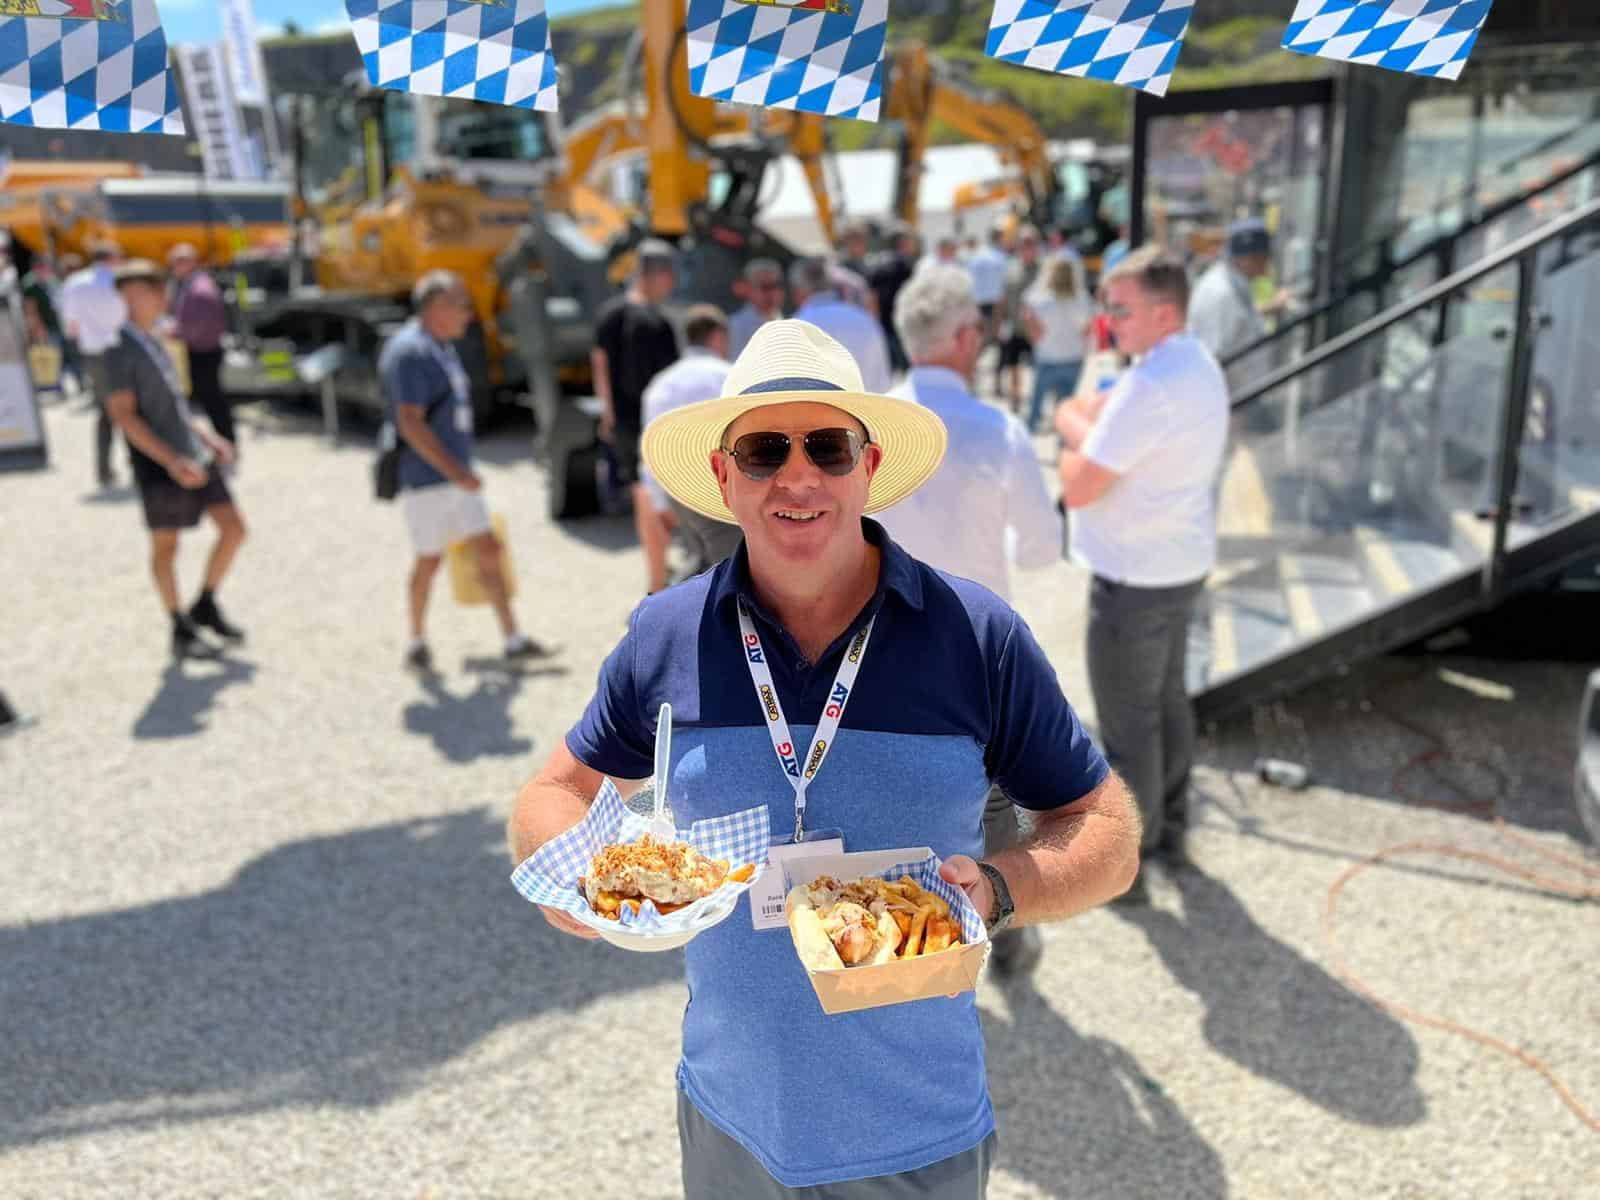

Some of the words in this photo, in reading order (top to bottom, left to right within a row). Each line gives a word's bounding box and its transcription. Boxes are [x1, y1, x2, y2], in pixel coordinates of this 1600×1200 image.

[744, 634, 764, 664] ATG
[826, 682, 849, 718] ATG
[777, 742, 799, 778] ATG
